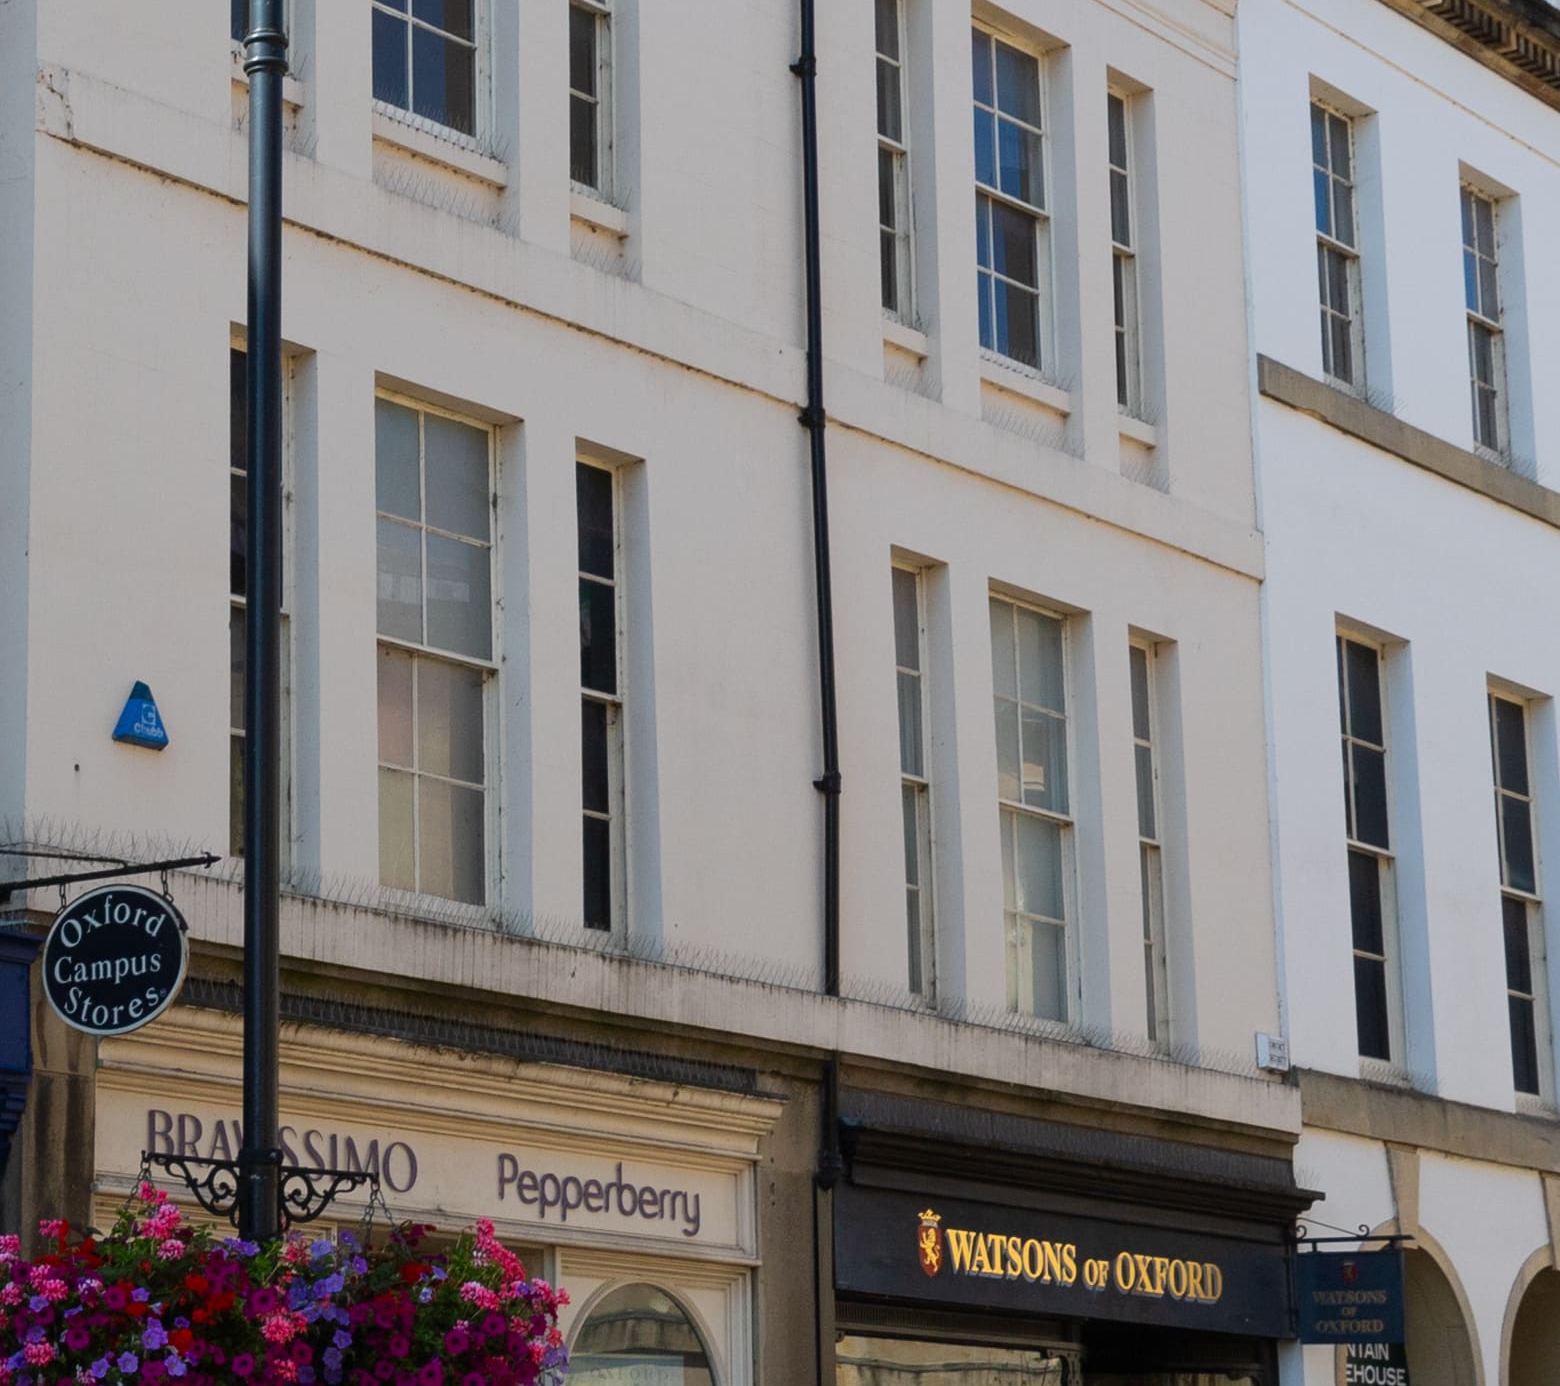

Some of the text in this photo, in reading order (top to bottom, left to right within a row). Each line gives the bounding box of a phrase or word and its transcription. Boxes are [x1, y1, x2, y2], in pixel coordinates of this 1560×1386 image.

[60, 894, 167, 948] Oxford
[54, 953, 161, 984] Campus
[64, 986, 160, 1026] Stores
[497, 1153, 701, 1237] Pepperberry
[946, 1228, 1223, 1302] WATSONS OF OXFORD
[1312, 1290, 1387, 1305] WATSONS
[1341, 1306, 1358, 1317] OF
[1315, 1319, 1385, 1334] OXFORD
